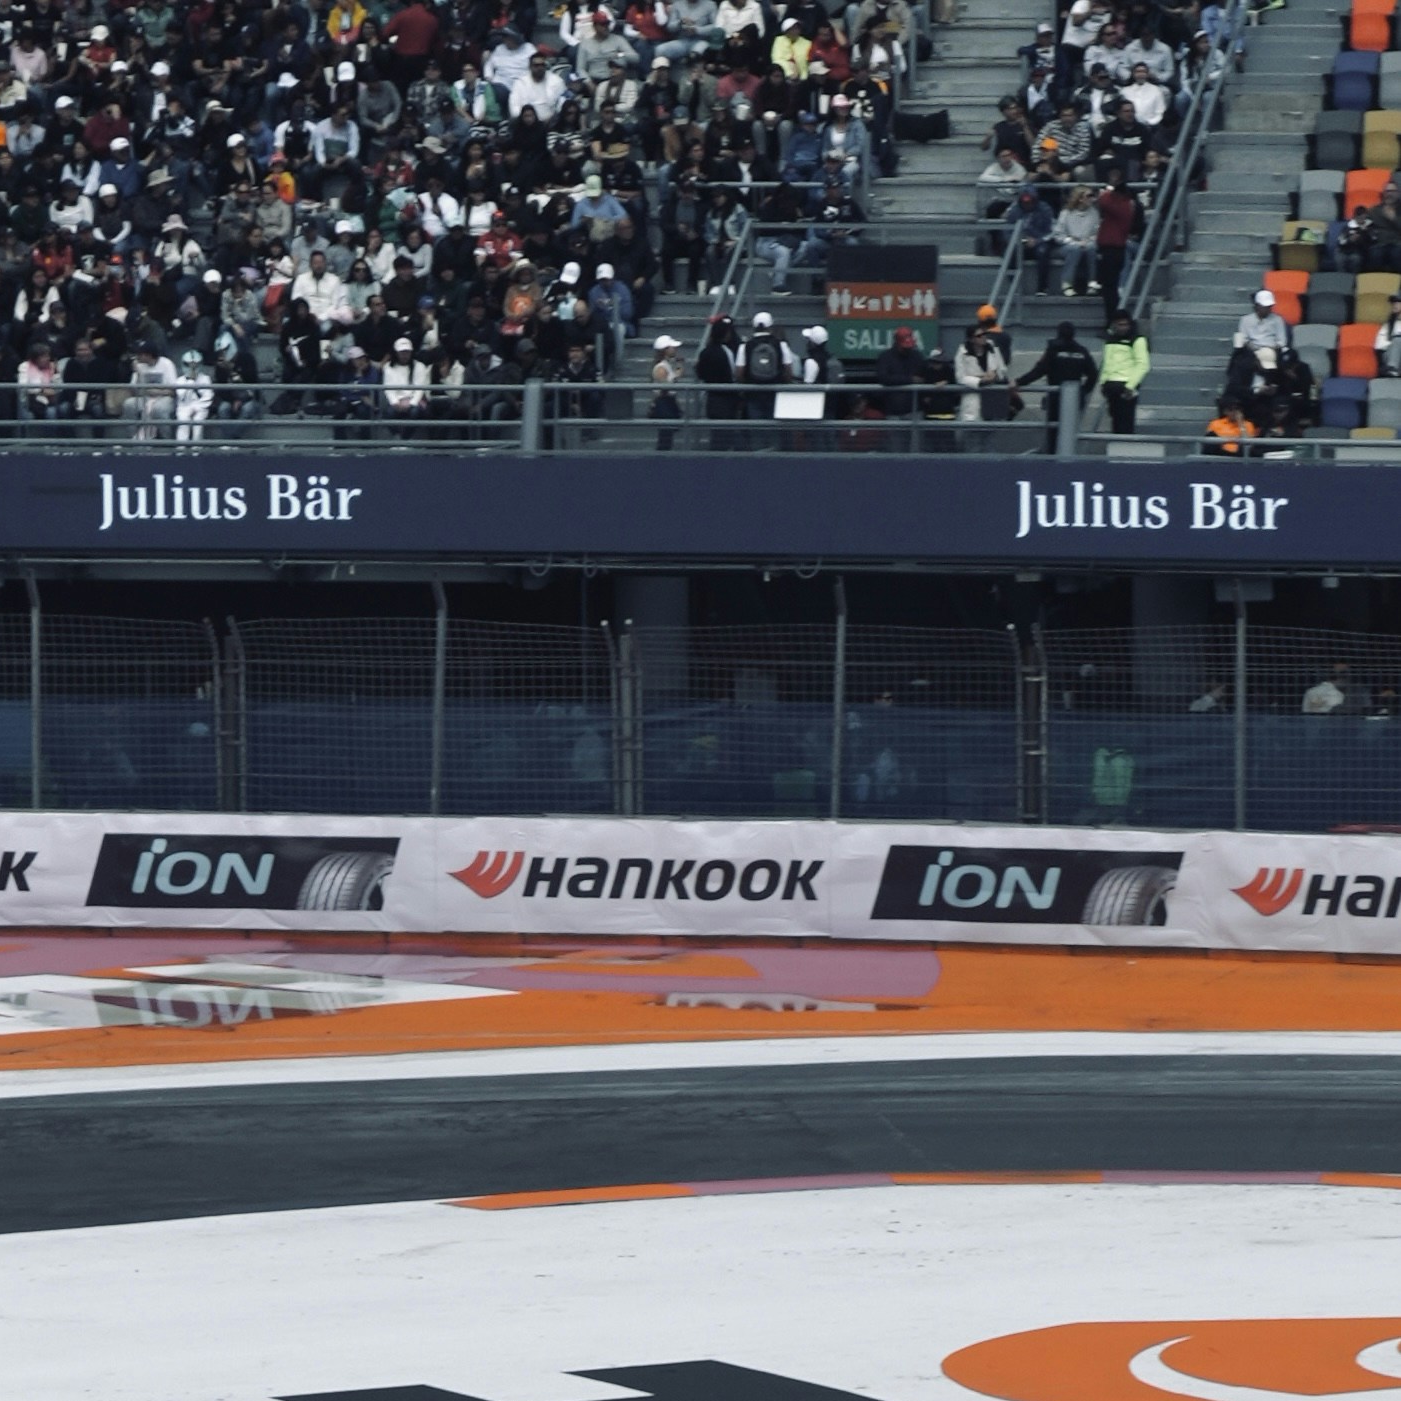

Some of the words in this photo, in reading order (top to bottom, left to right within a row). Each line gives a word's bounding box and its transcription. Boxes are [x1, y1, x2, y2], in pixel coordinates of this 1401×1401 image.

[844, 328, 924, 350] SALIA
[99, 474, 248, 530] Julius
[266, 474, 363, 521] Bär
[1015, 481, 1170, 538] Julius
[1189, 483, 1289, 530] Bär
